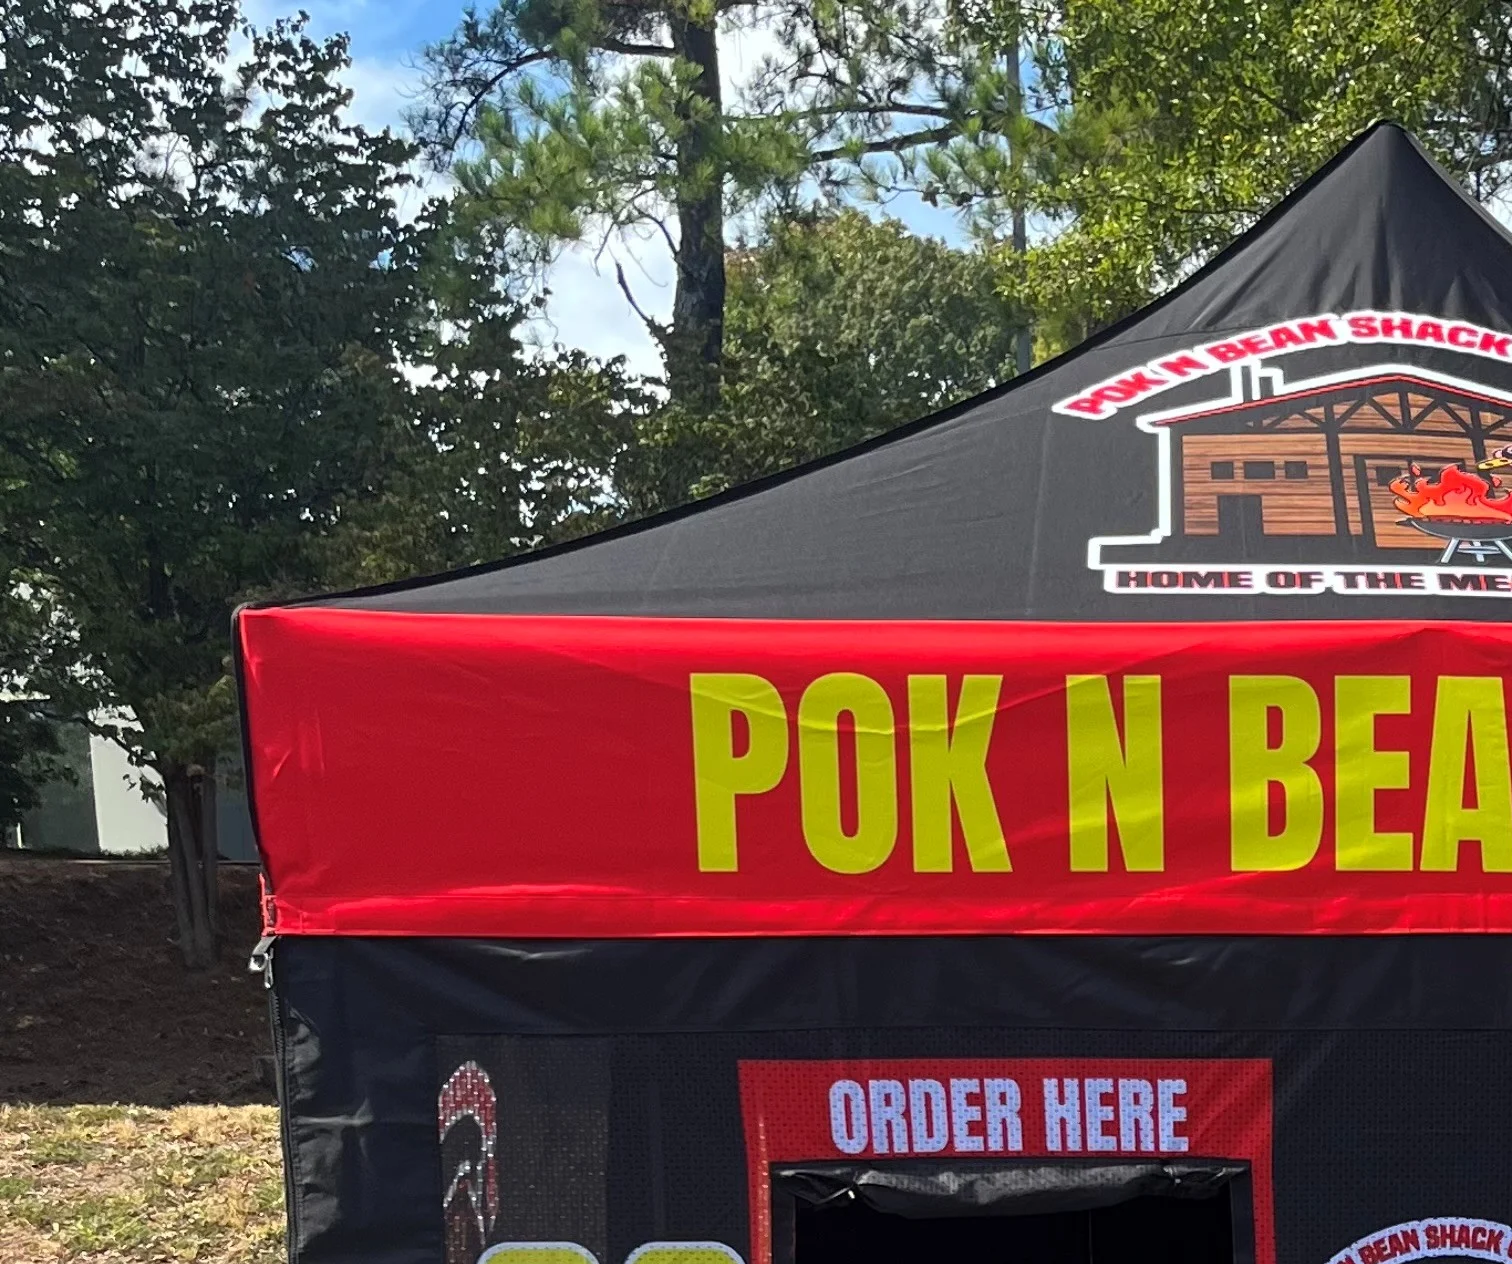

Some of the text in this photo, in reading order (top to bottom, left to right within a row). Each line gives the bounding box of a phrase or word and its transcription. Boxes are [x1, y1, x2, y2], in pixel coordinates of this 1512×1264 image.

[1063, 370, 1170, 415] POK
[1157, 354, 1210, 378] N
[1205, 318, 1338, 363] BEAN
[1115, 570, 1254, 589] HOME
[1265, 570, 1325, 590] OF
[1333, 571, 1427, 591] THE
[690, 672, 1013, 874] POK
[1066, 674, 1164, 872] N
[828, 1077, 1190, 1155] ORDER HERE
[1425, 1223, 1505, 1250] SHACK
